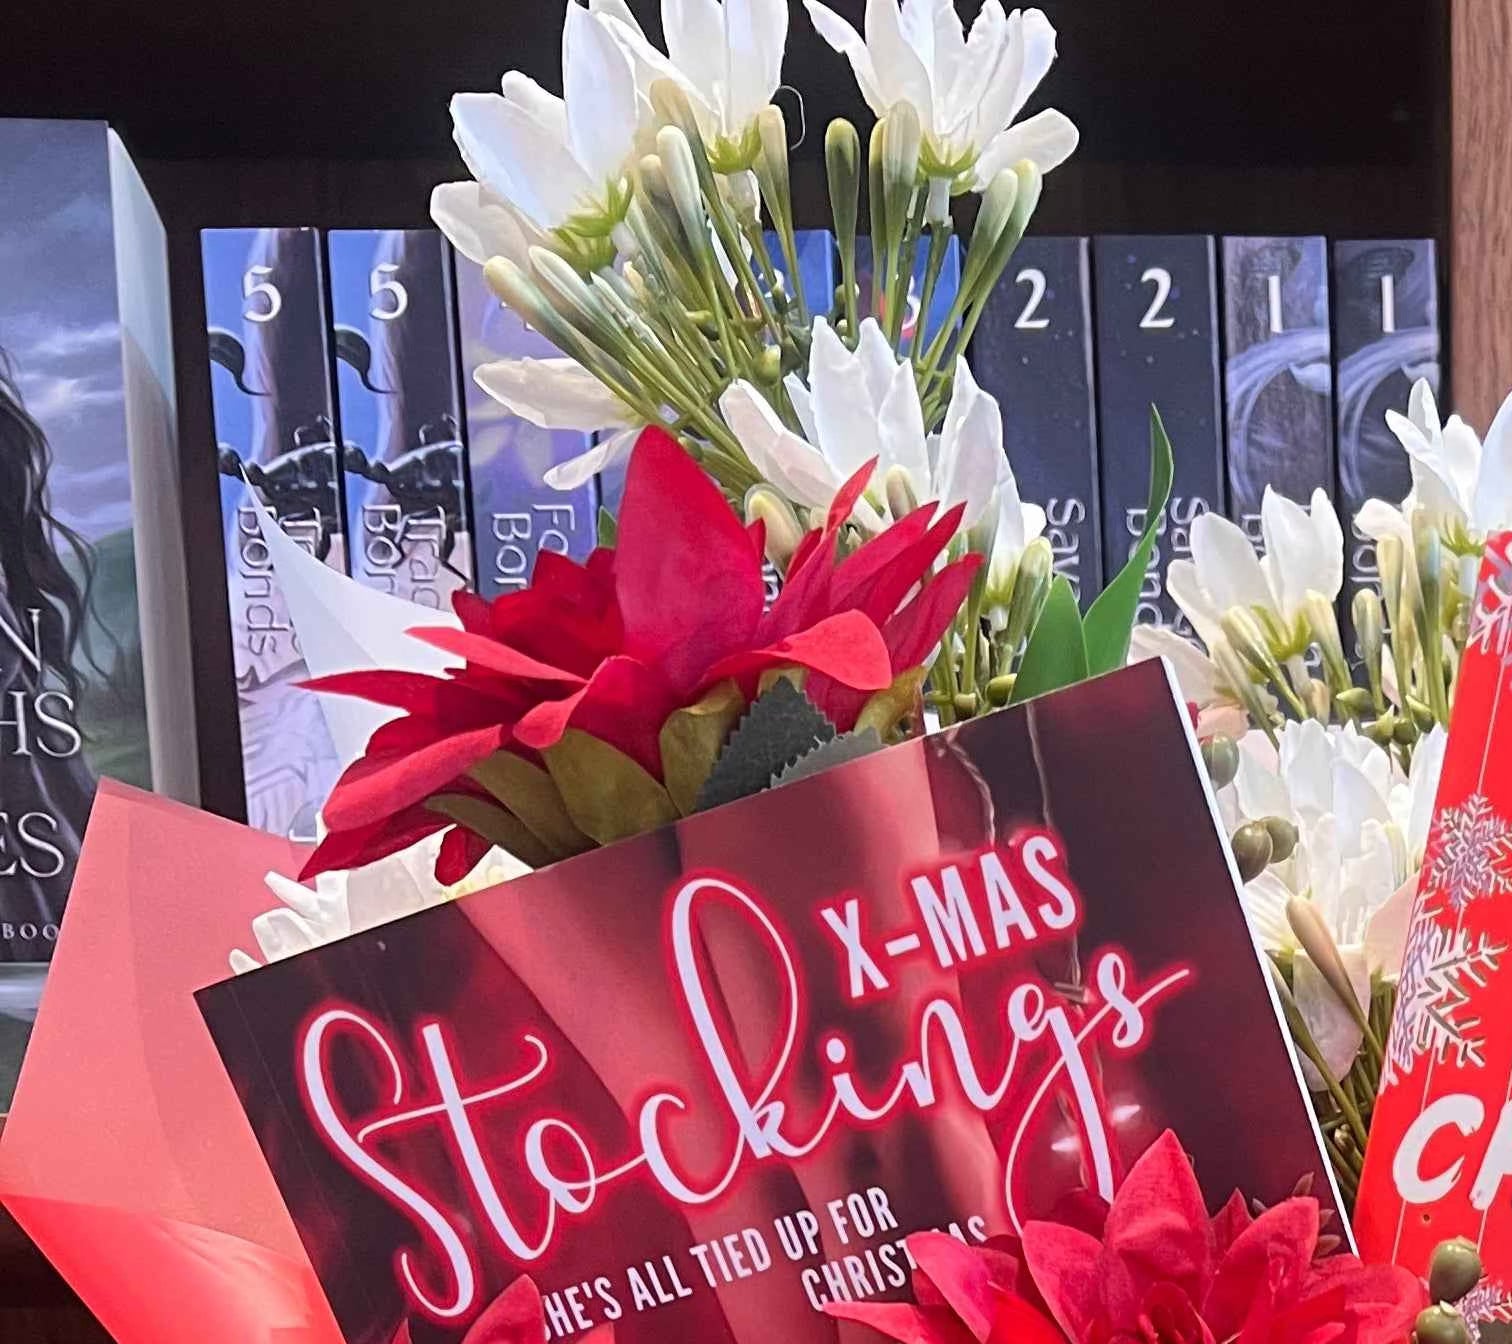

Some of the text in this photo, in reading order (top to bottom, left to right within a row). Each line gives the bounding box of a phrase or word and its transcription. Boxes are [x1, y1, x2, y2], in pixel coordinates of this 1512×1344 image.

[243, 265, 283, 323] 5
[368, 263, 409, 321] 5
[1014, 268, 1051, 329] 2
[1139, 267, 1175, 329] 2
[822, 833, 1080, 999] X-MAS
[300, 874, 1191, 1323] Stockings
[626, 1255, 693, 1312] ALL
[689, 1227, 773, 1288] TIED
[773, 1209, 823, 1262] UP
[827, 1186, 899, 1244] FOR
